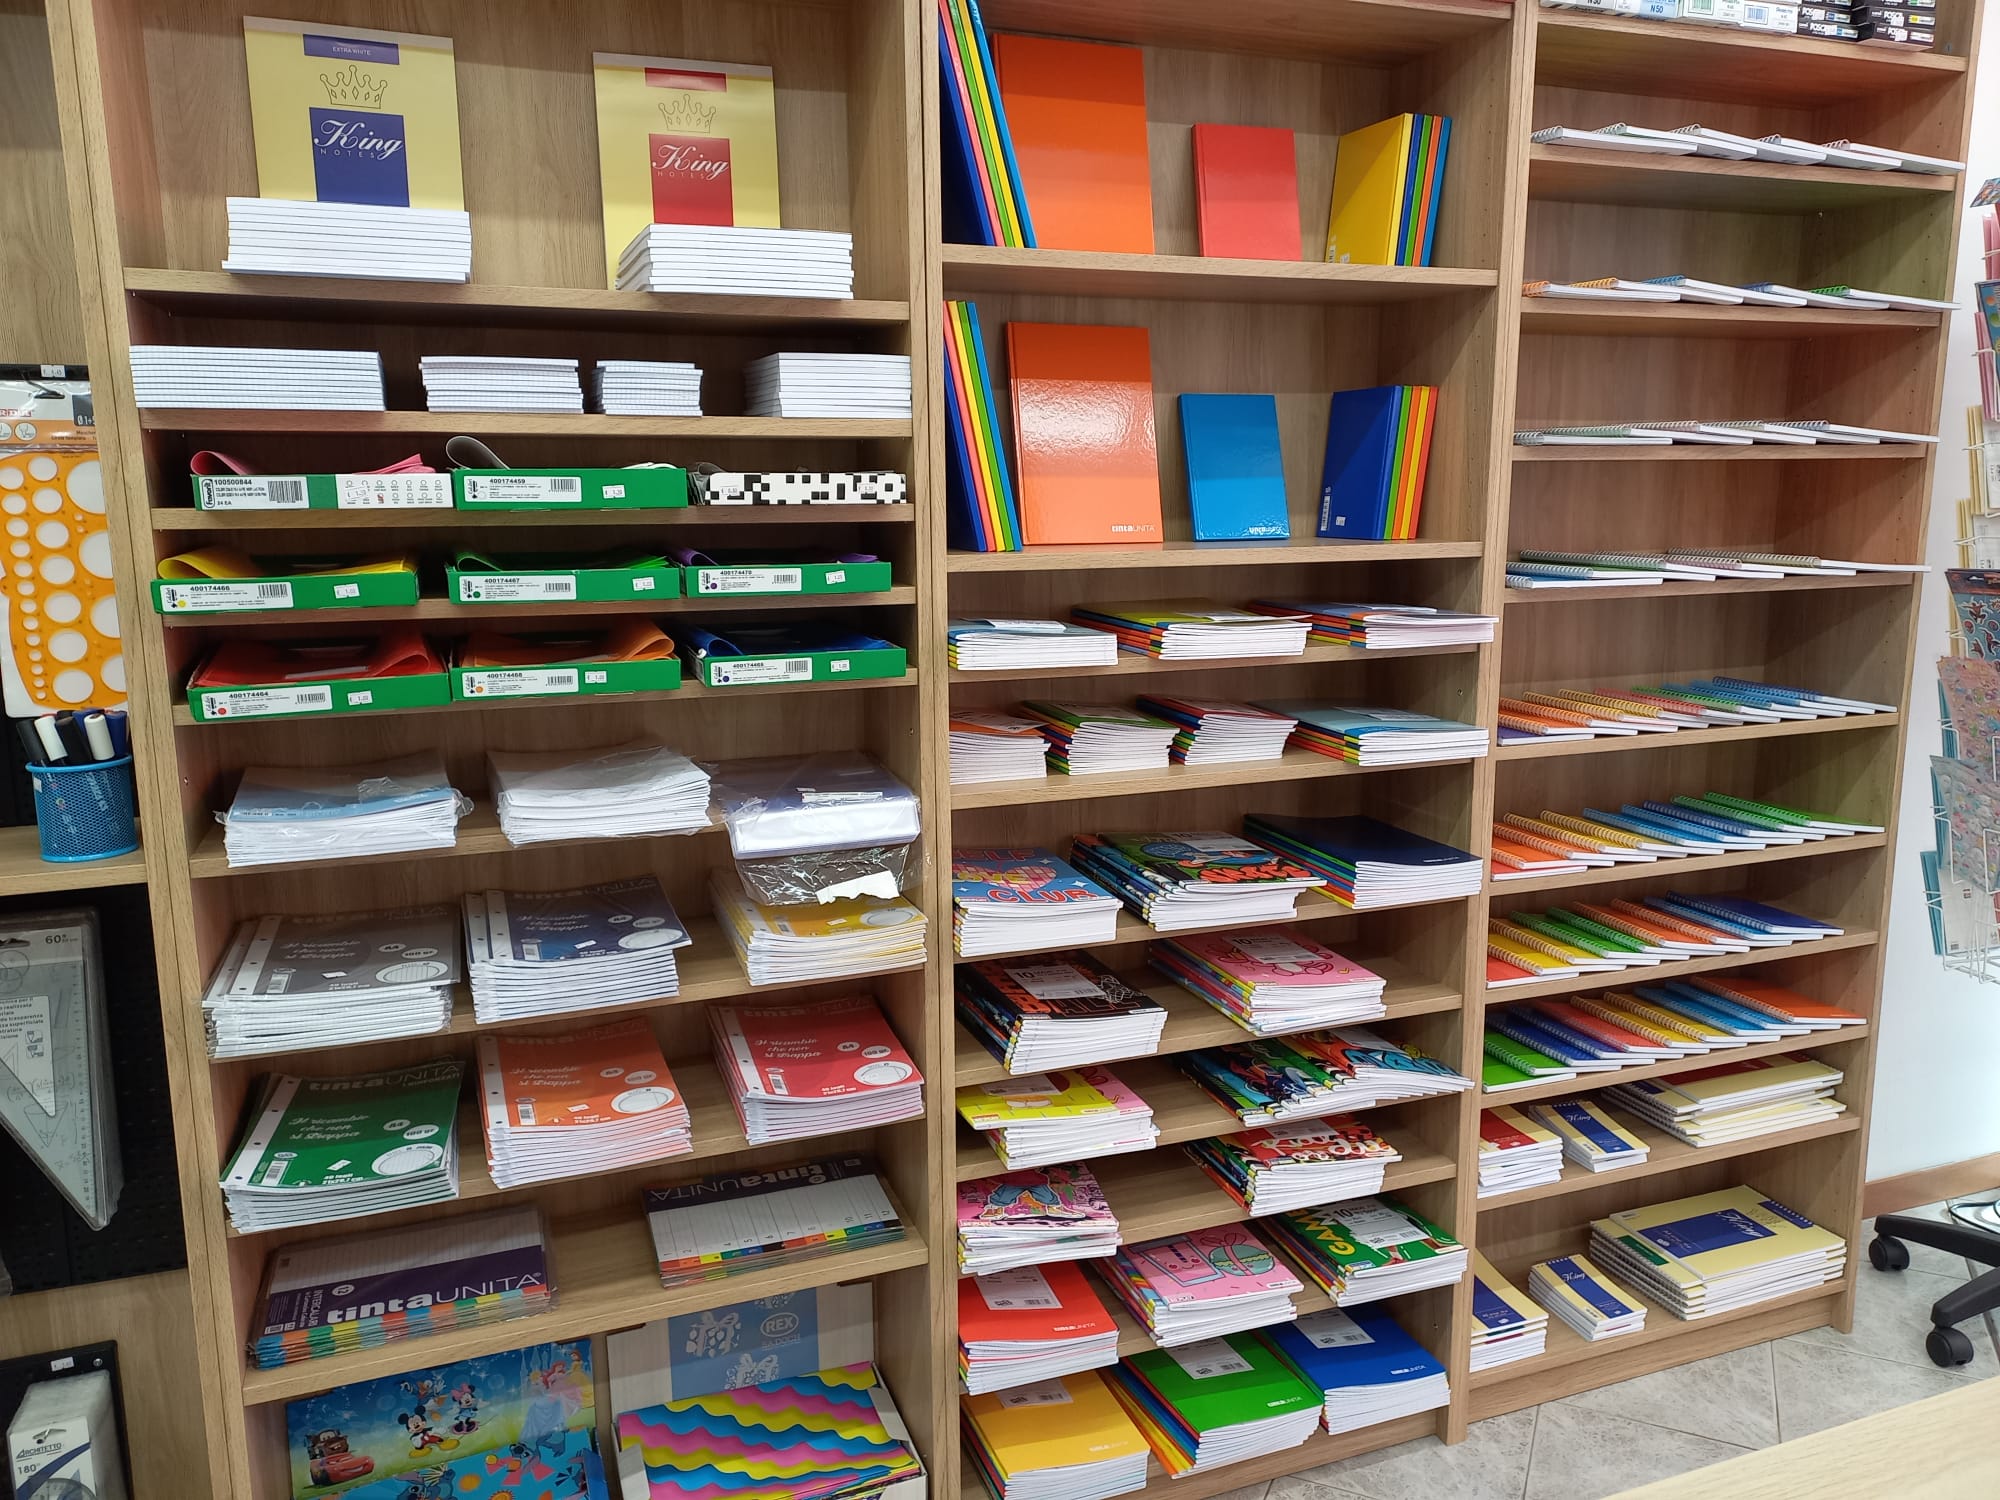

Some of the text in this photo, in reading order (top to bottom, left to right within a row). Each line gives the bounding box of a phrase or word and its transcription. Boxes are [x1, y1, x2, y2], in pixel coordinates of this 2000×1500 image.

[313, 119, 404, 161] King
[319, 147, 376, 159] NOTES
[652, 144, 729, 181] King
[656, 170, 706, 180] NOTES
[203, 481, 213, 506] favorit
[987, 888, 1099, 903] CLUB
[650, 1164, 825, 1202] tintaUNITA
[1334, 1208, 1354, 1218] 10
[327, 1273, 541, 1324] tintaUNITA
[766, 1316, 794, 1333] REX
[16, 1442, 63, 1460] ARCHITETTO
